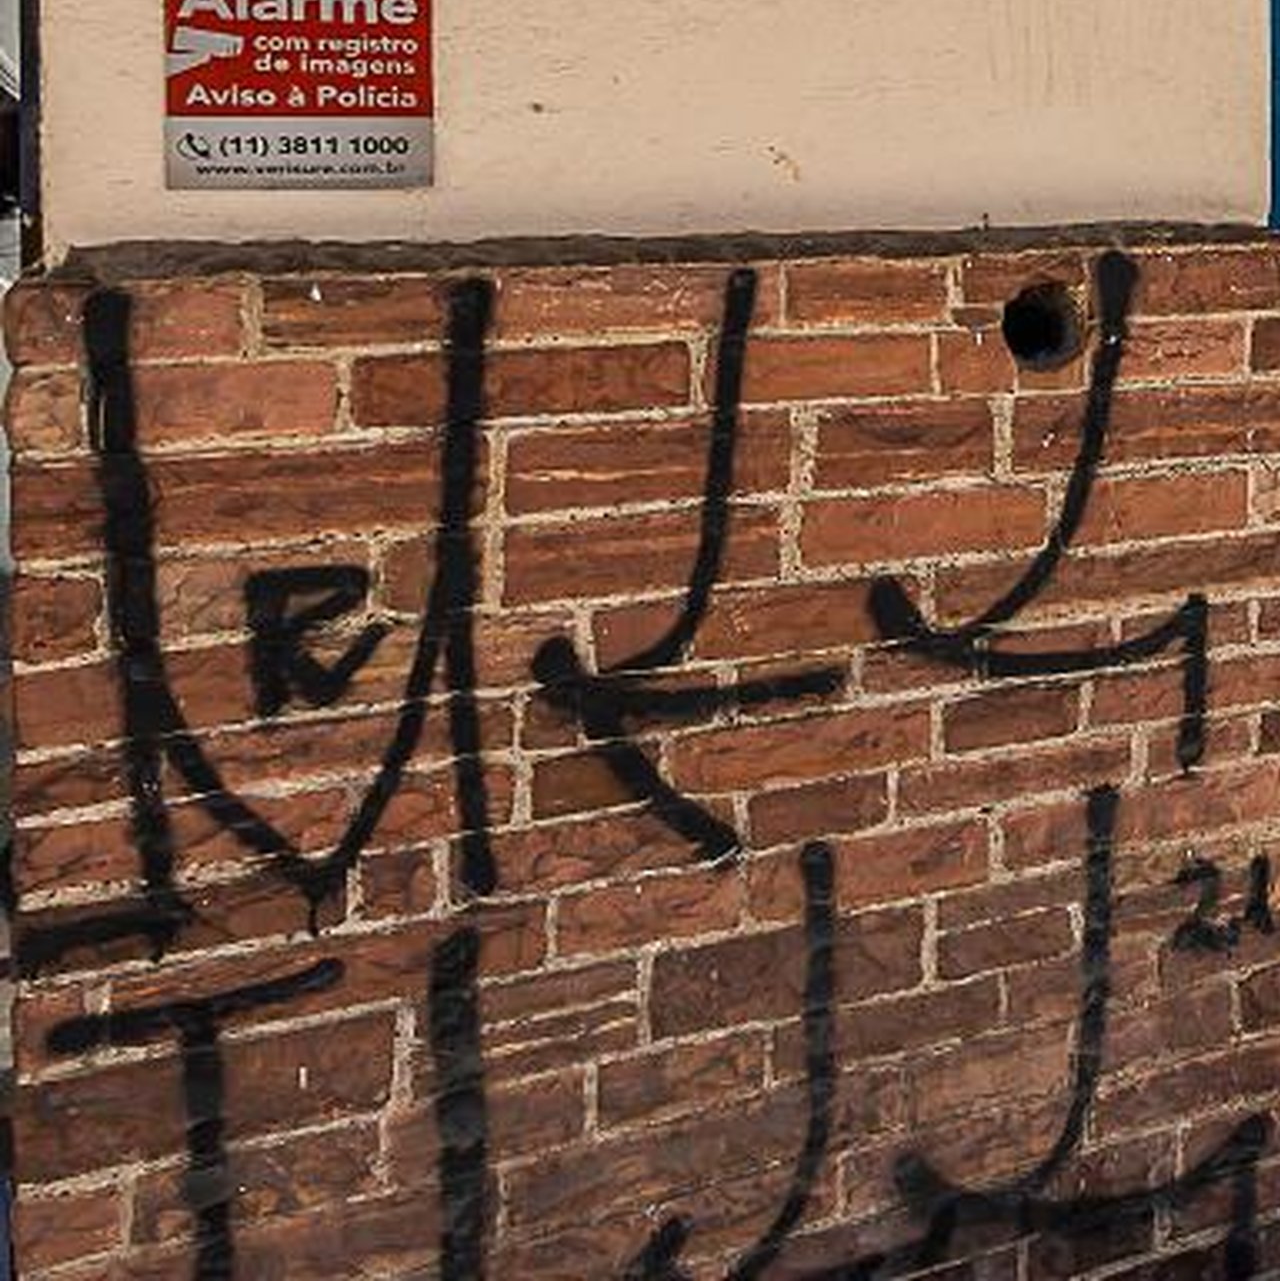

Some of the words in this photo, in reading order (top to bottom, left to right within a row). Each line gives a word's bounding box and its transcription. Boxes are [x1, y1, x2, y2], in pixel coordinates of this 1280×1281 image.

[253, 35, 310, 53] com
[317, 33, 420, 56] registro
[253, 53, 290, 72] de
[300, 54, 416, 78] imagens
[185, 84, 277, 106] Aviso
[218, 137, 269, 157] (11)
[277, 136, 339, 155] 3811
[350, 135, 410, 155] 1000
